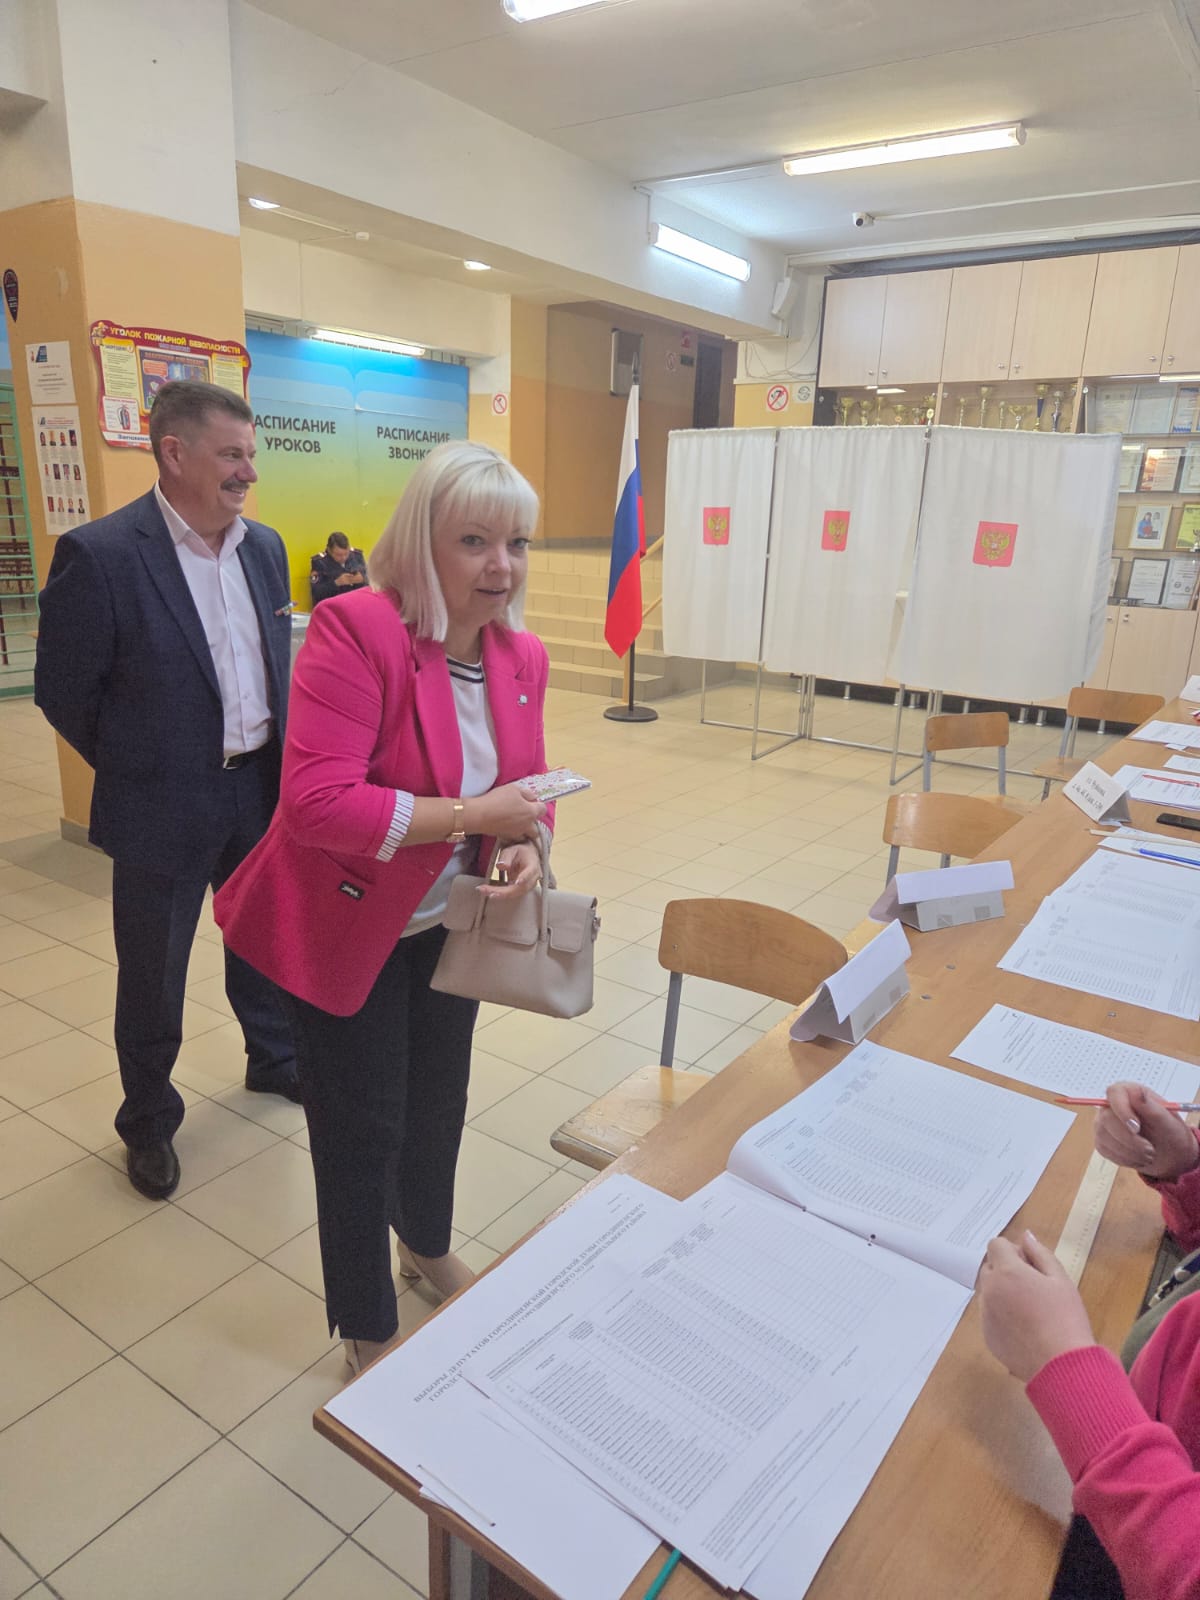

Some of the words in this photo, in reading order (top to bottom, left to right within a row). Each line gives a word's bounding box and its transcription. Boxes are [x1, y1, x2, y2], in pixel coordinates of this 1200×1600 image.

[110, 327, 142, 339] УГОЛОК
[144, 332, 187, 346] ПОЖАРНОЙ
[189, 340, 241, 354] БЕЗОПАСНОСТИ
[254, 414, 336, 434] АСПИСАНИЕ
[376, 426, 450, 443] РАСПИСАНИЕ
[264, 436, 321, 453] УРОКОВ
[388, 446, 431, 461] ЗВОНК
[412, 1371, 448, 1404] ВЫБОРЫ
[446, 1336, 491, 1375] ДЕПУТАТОВ
